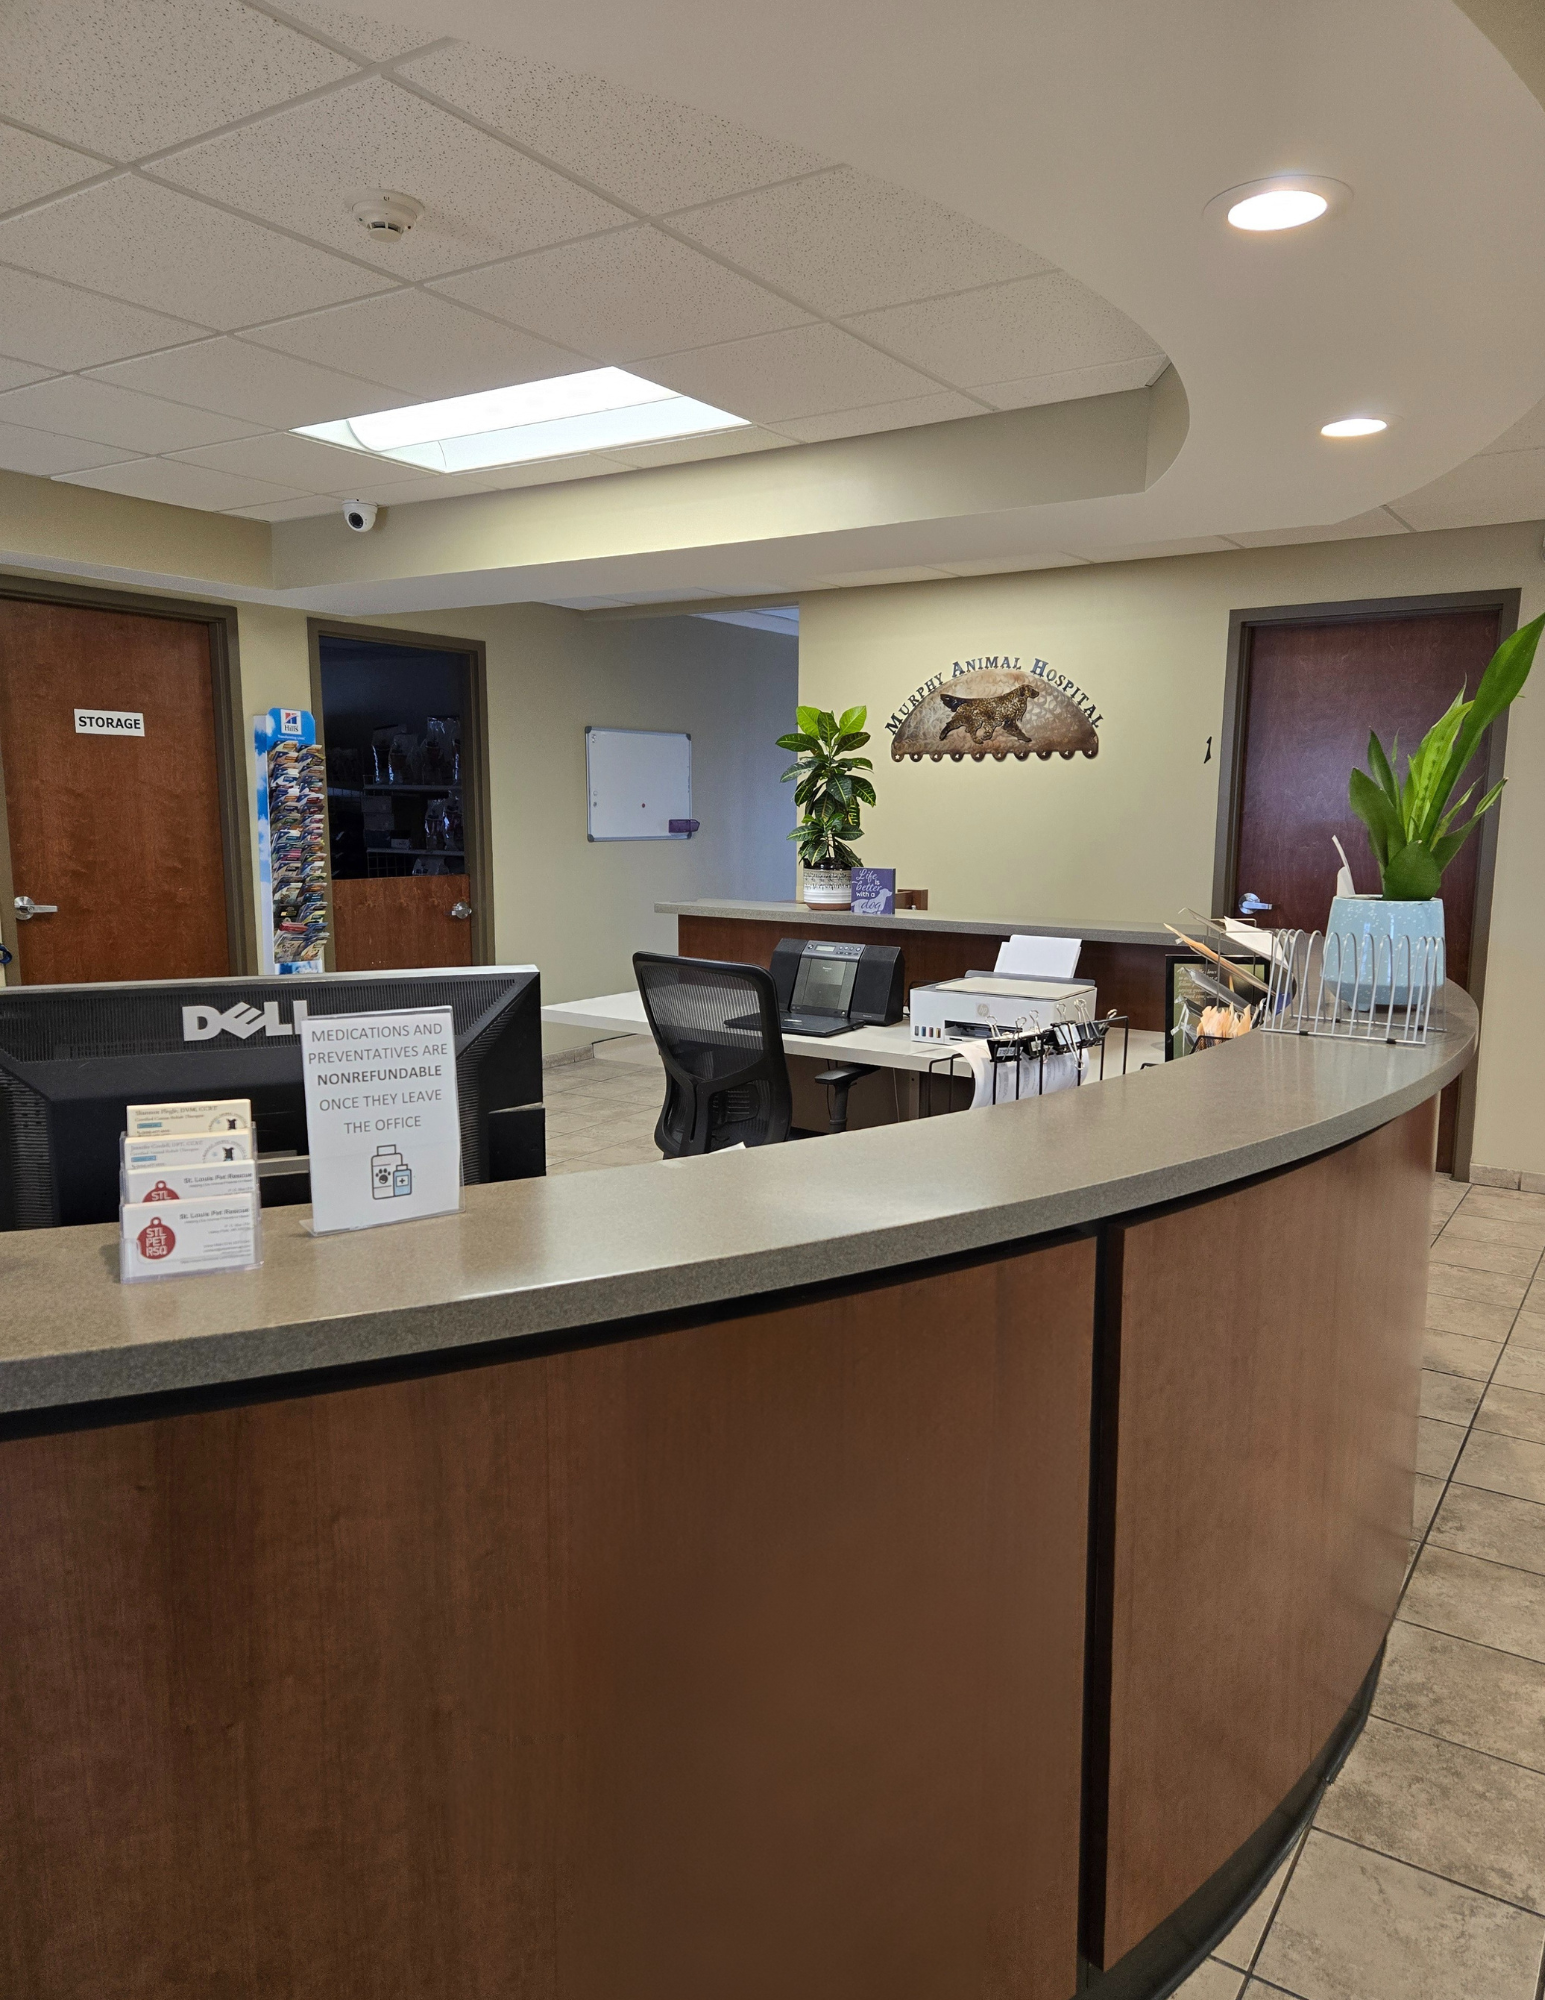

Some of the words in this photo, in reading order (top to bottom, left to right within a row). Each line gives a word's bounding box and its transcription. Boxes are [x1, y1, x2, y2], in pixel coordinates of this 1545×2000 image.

[885, 672, 944, 736] MURPHY
[951, 656, 1022, 678] ANIMAL
[1030, 658, 1104, 728] HOSPITAL
[78, 716, 141, 729] STORAGE
[856, 869, 878, 883] Life
[852, 880, 882, 891] better
[861, 900, 881, 914] dog
[311, 1024, 410, 1042] MEDICATIONS
[413, 1023, 442, 1036] AND
[308, 1047, 419, 1065] PREVENTATIVES
[422, 1044, 448, 1056] ARE
[317, 1065, 442, 1086] NONREFUNDABLE
[319, 1096, 359, 1111] ONCE
[362, 1093, 397, 1108] THEY
[402, 1089, 442, 1104] LEAVE
[344, 1121, 371, 1134] THE
[375, 1115, 421, 1132] OFFICE
[151, 1190, 171, 1200] STL
[146, 1227, 167, 1237] STL
[146, 1236, 167, 1247] PET
[146, 1245, 168, 1257] RSQ
